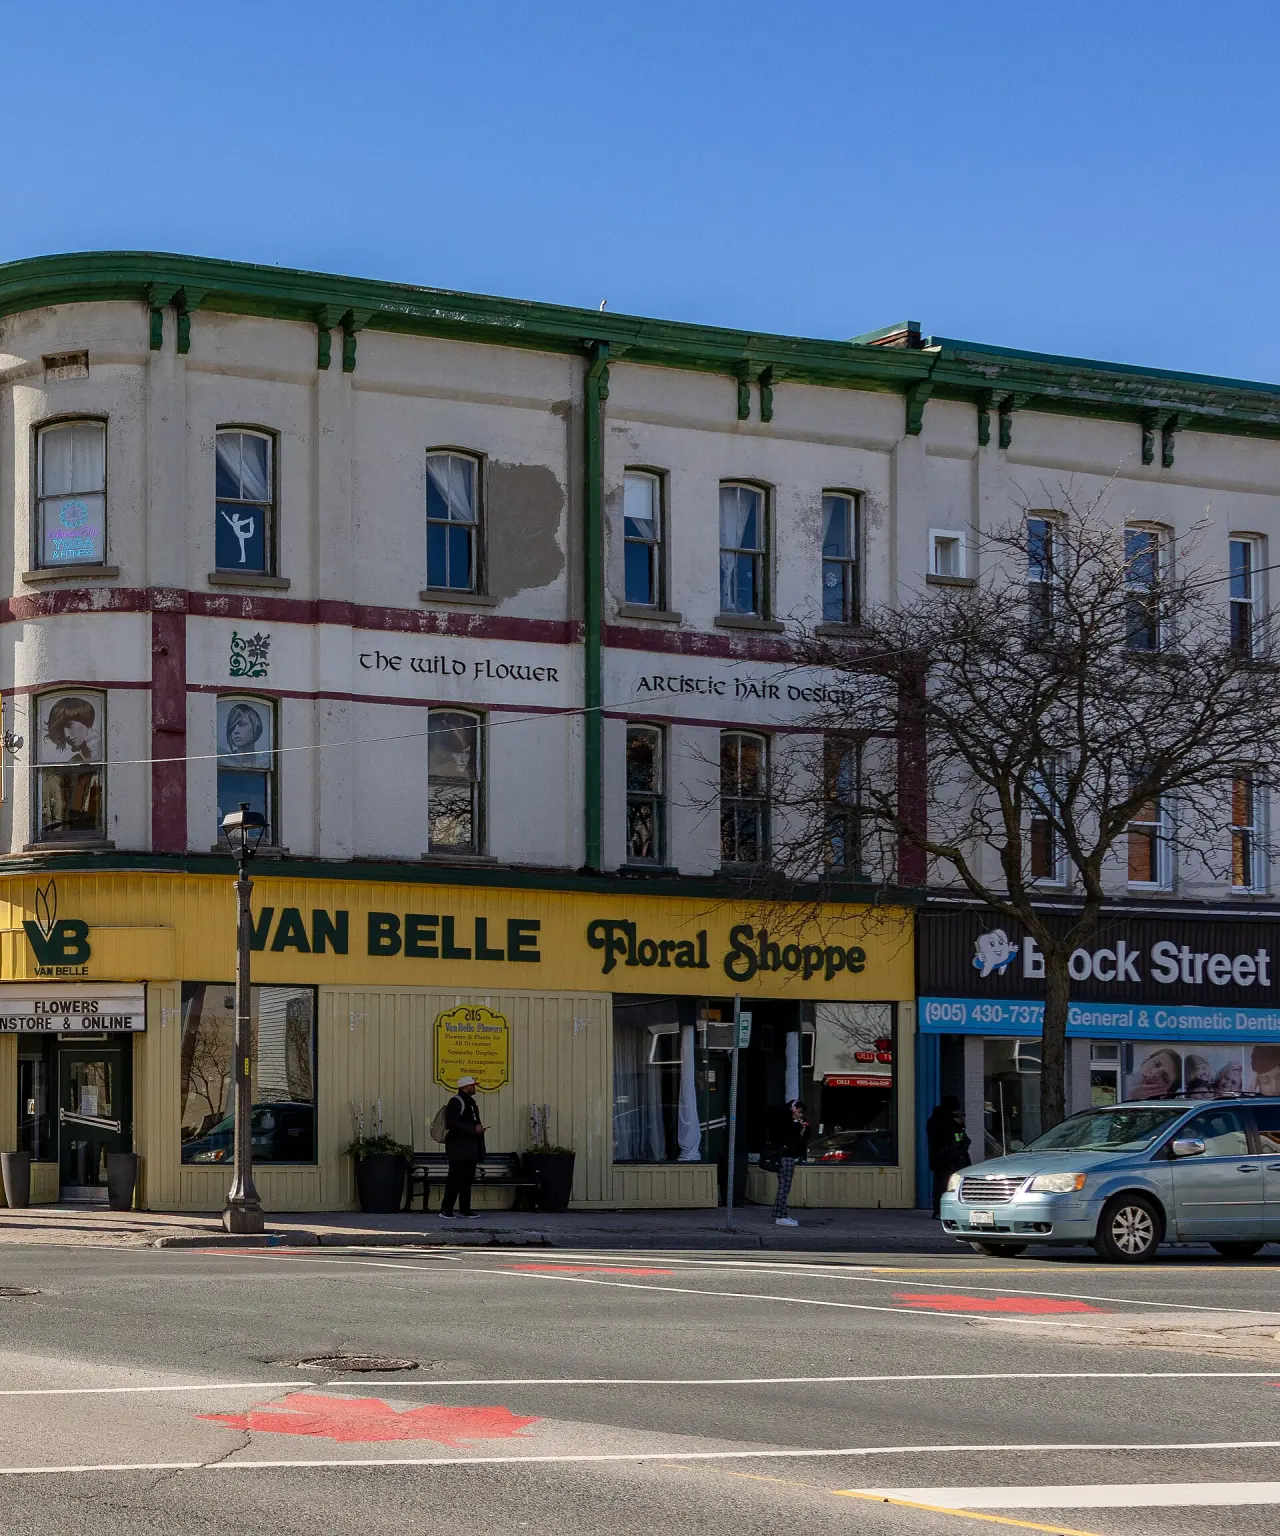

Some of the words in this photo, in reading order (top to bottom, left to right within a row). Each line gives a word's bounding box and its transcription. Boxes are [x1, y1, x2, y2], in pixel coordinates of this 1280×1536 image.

[52, 537, 93, 550] YOGA
[52, 550, 60, 559] &
[61, 549, 94, 558] FITNESS
[248, 906, 349, 955] VAN
[367, 911, 541, 963] BELLE
[22, 919, 92, 966] VB
[587, 919, 710, 975] Floral
[723, 923, 867, 983] Shoppe
[1022, 936, 1142, 983] Bock
[1150, 941, 1272, 987] Street
[34, 966, 53, 976] VAN
[55, 966, 89, 976] BELLE
[34, 1001, 99, 1014] FLOWERS
[63, 1017, 71, 1030] &
[81, 1016, 132, 1029] ONLINE
[925, 1002, 967, 1025] (905)
[1069, 1007, 1133, 1027] General
[1137, 1010, 1150, 1027] &
[1154, 1011, 1232, 1030] Cosmetic
[445, 1022, 457, 1032] Van
[457, 1022, 475, 1032] Belle
[477, 1023, 503, 1033] Flowers
